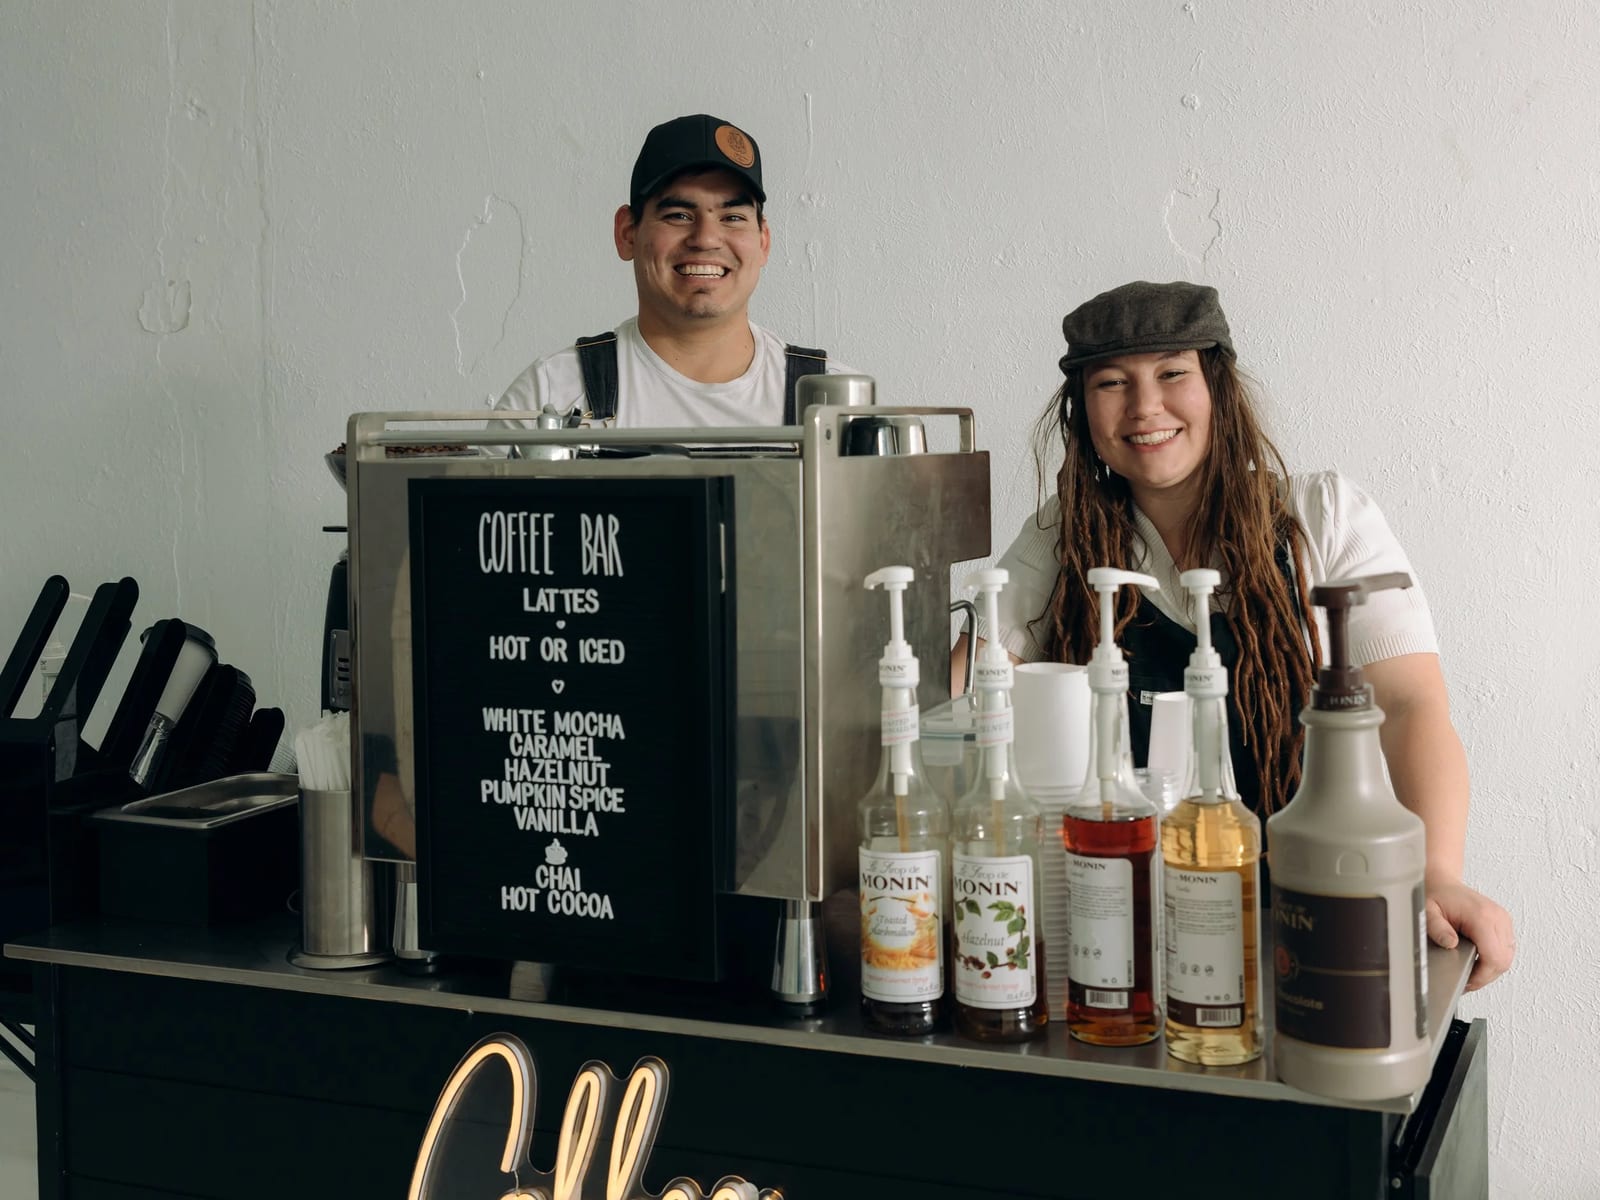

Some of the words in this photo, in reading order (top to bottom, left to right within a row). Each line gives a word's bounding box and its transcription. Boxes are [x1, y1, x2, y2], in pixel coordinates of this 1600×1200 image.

[478, 511, 555, 575] COFFEE
[580, 513, 624, 577] BAR
[523, 588, 599, 614] LATTES
[489, 635, 530, 661] HOT
[540, 637, 568, 663] OR
[579, 638, 625, 664] ICED
[482, 707, 547, 734] WHITE
[554, 711, 626, 740] MOCHA
[509, 733, 602, 761] CARAMEL
[505, 758, 611, 787] HAZELNUT
[481, 780, 565, 808] PUMPKIN
[569, 785, 625, 813] SPICE
[513, 806, 599, 836] VANILLA
[535, 865, 581, 891] CHAI
[1072, 859, 1107, 871] MONIN
[1179, 873, 1219, 885] MONIN
[862, 872, 929, 891] MONIN
[954, 876, 1018, 896] MONIN
[501, 886, 540, 912] HOT
[547, 890, 614, 919] COCOA
[961, 929, 1005, 947] Hazelnut
